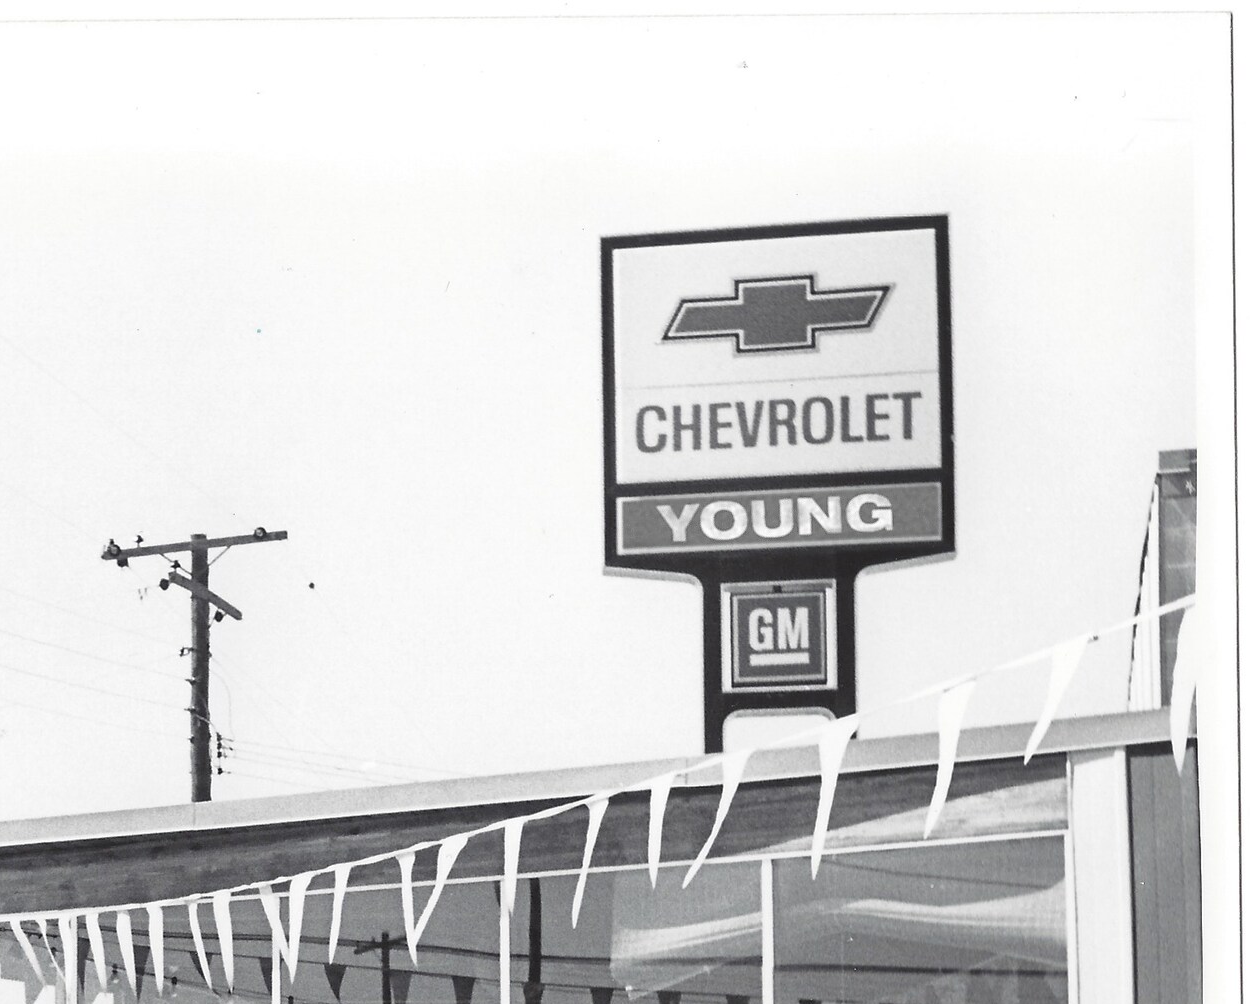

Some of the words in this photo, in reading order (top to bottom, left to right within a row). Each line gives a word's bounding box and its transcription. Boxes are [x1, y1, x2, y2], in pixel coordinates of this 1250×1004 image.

[635, 391, 922, 453] CHEVROLET
[656, 494, 894, 543] YOUNG
[749, 607, 810, 651] GM
